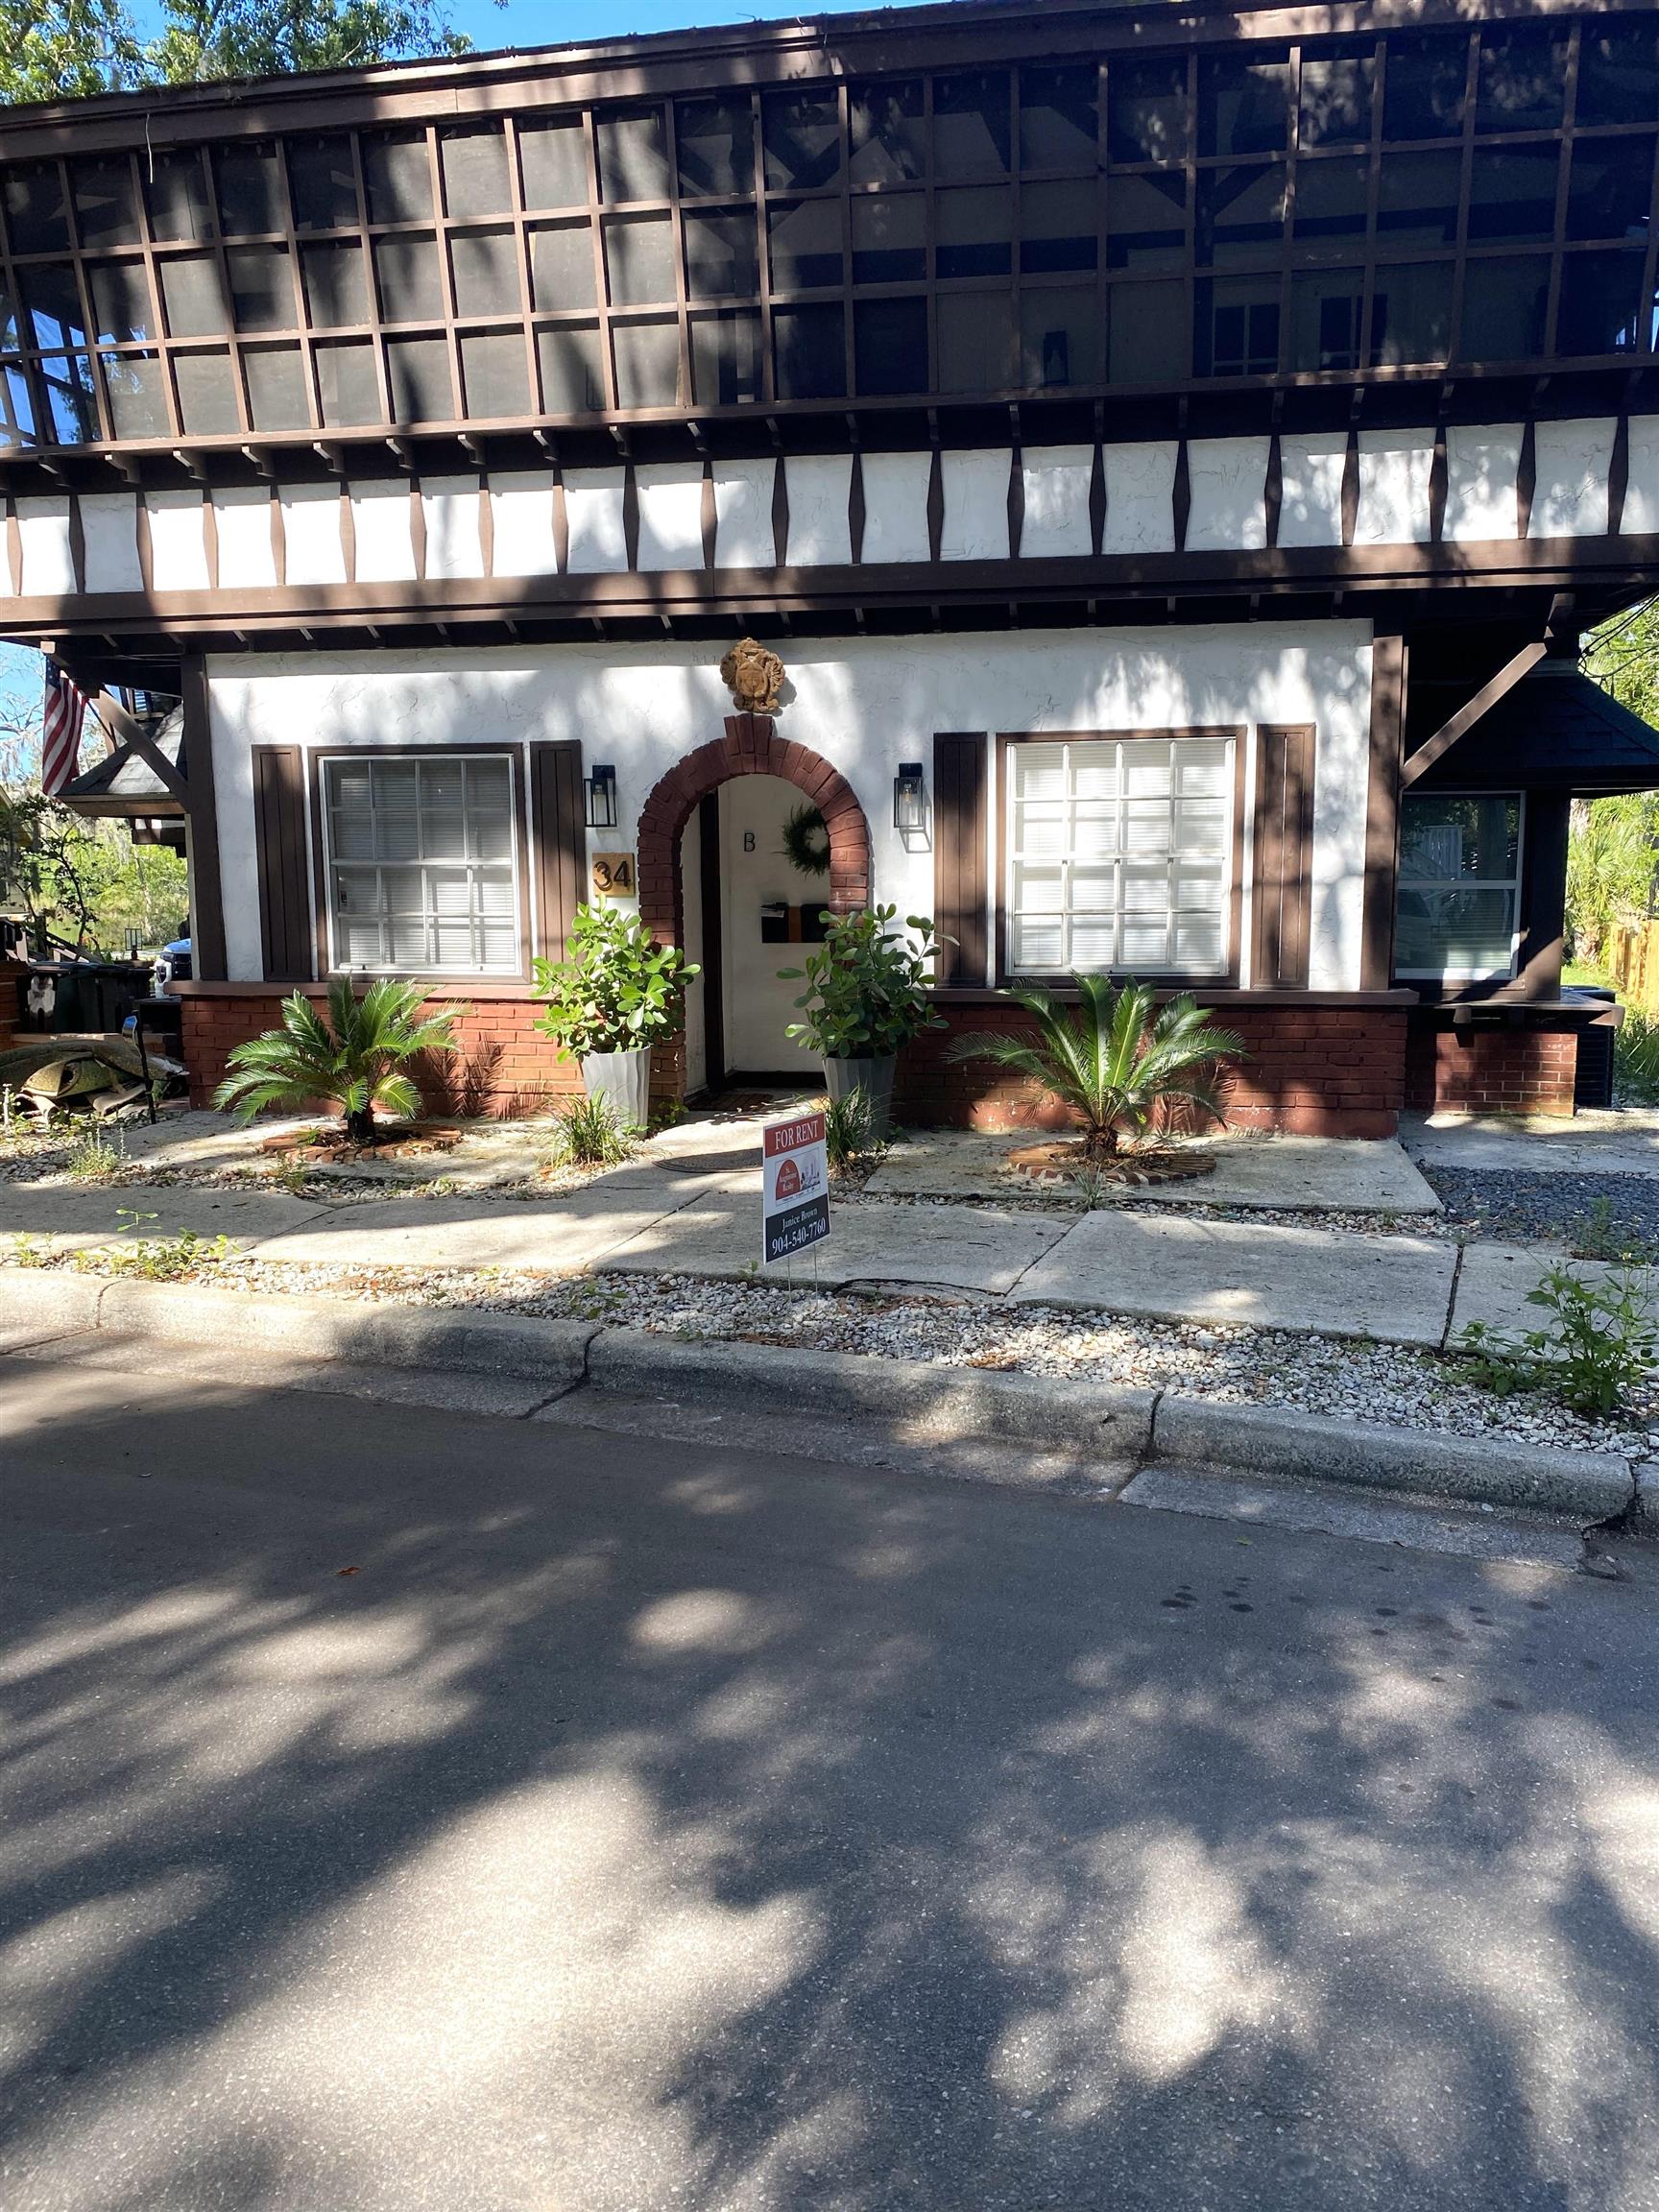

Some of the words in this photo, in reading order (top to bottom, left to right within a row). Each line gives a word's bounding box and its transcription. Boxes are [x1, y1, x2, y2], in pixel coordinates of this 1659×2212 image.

[743, 832, 756, 853] B
[593, 860, 631, 891] 34
[775, 1127, 795, 1150] FOR
[796, 1119, 818, 1143] RENT
[781, 1215, 801, 1233] Janice
[801, 1208, 818, 1221] Brown
[772, 1217, 826, 1256] 904-540-7760
